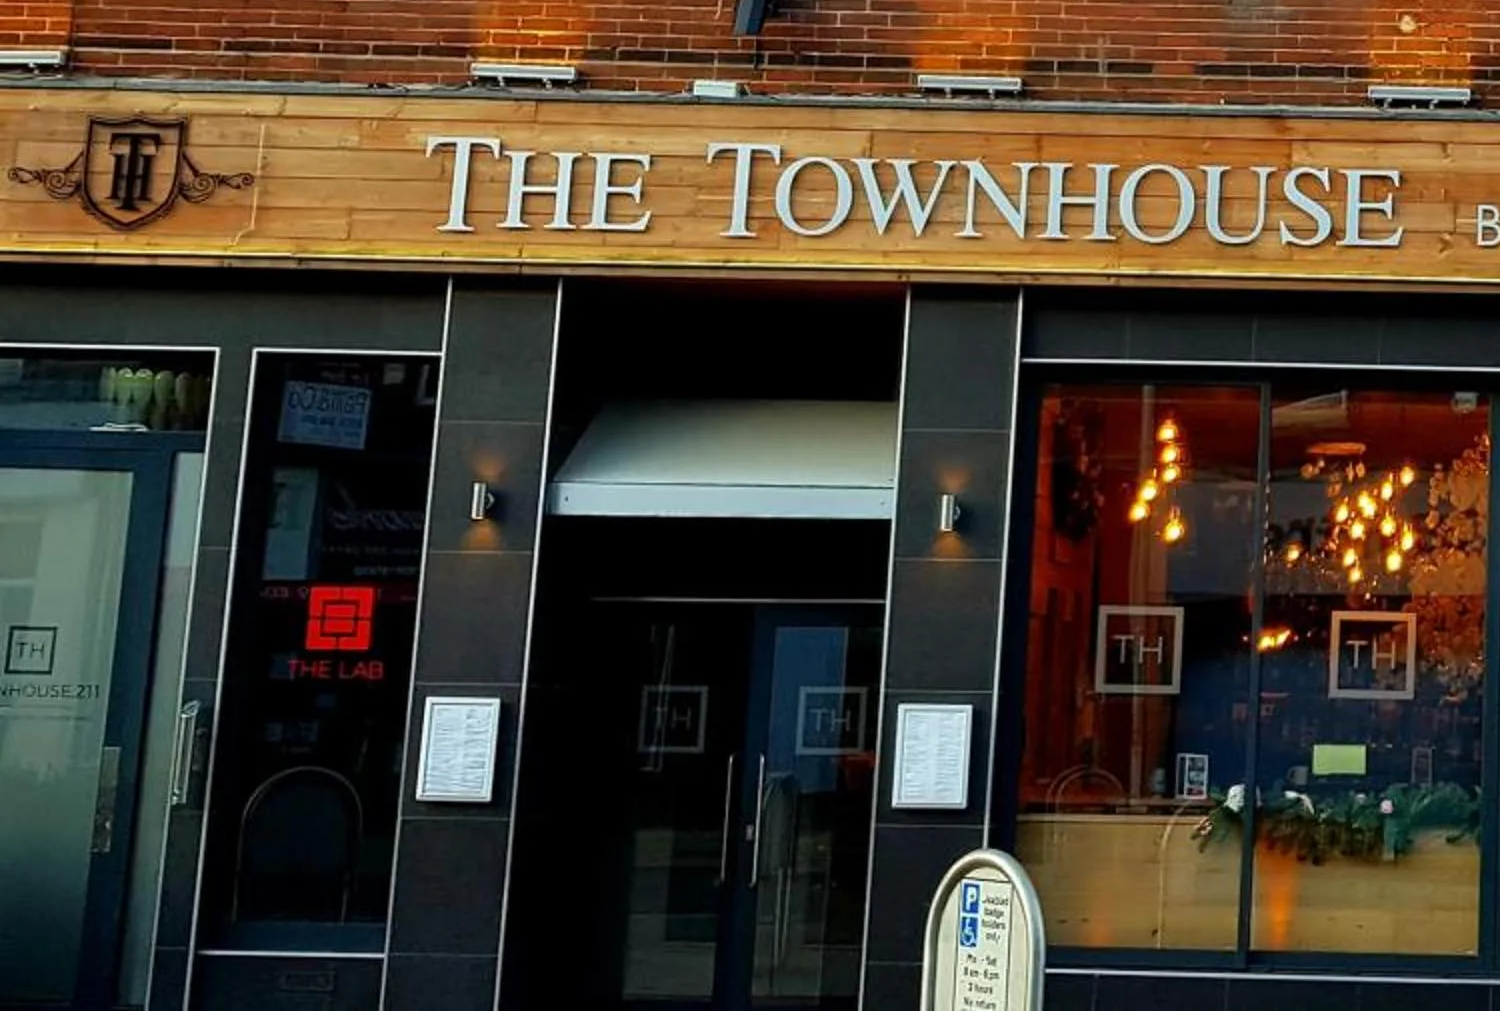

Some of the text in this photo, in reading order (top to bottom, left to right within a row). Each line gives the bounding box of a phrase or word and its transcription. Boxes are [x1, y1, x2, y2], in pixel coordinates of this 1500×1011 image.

[425, 135, 1405, 248] THE TOWNHOUSE
[16, 641, 45, 658] TH
[1112, 634, 1163, 666] TH
[1346, 639, 1397, 669] TH
[287, 660, 384, 681] THE LAB
[808, 707, 851, 733] TH
